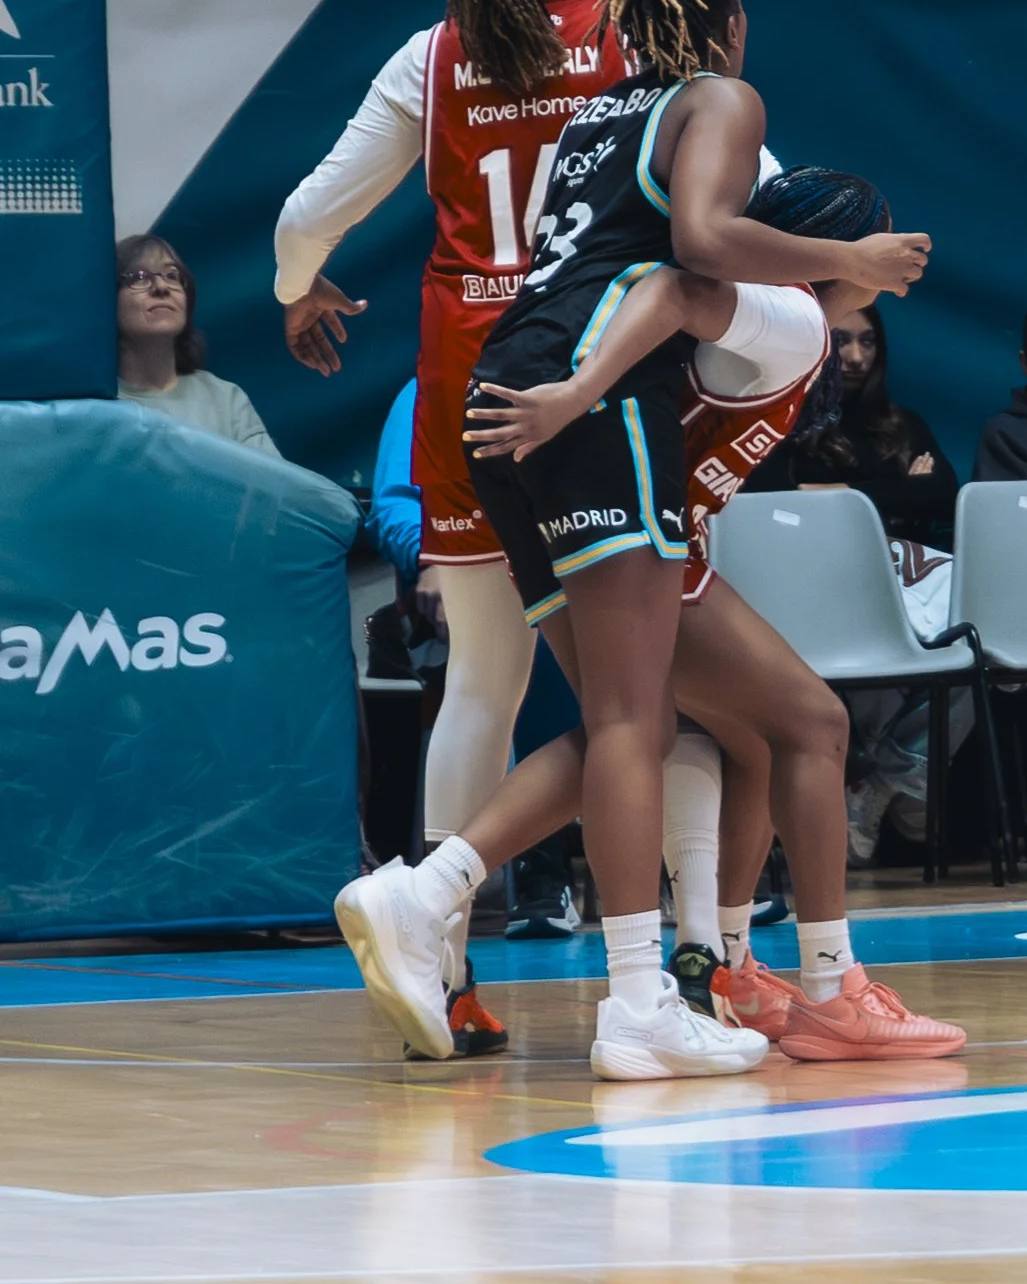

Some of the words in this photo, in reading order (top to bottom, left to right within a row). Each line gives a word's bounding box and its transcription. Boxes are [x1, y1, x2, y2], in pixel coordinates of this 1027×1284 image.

[467, 103, 518, 126] Kave
[521, 95, 587, 118] Home
[549, 508, 627, 538] MADRID
